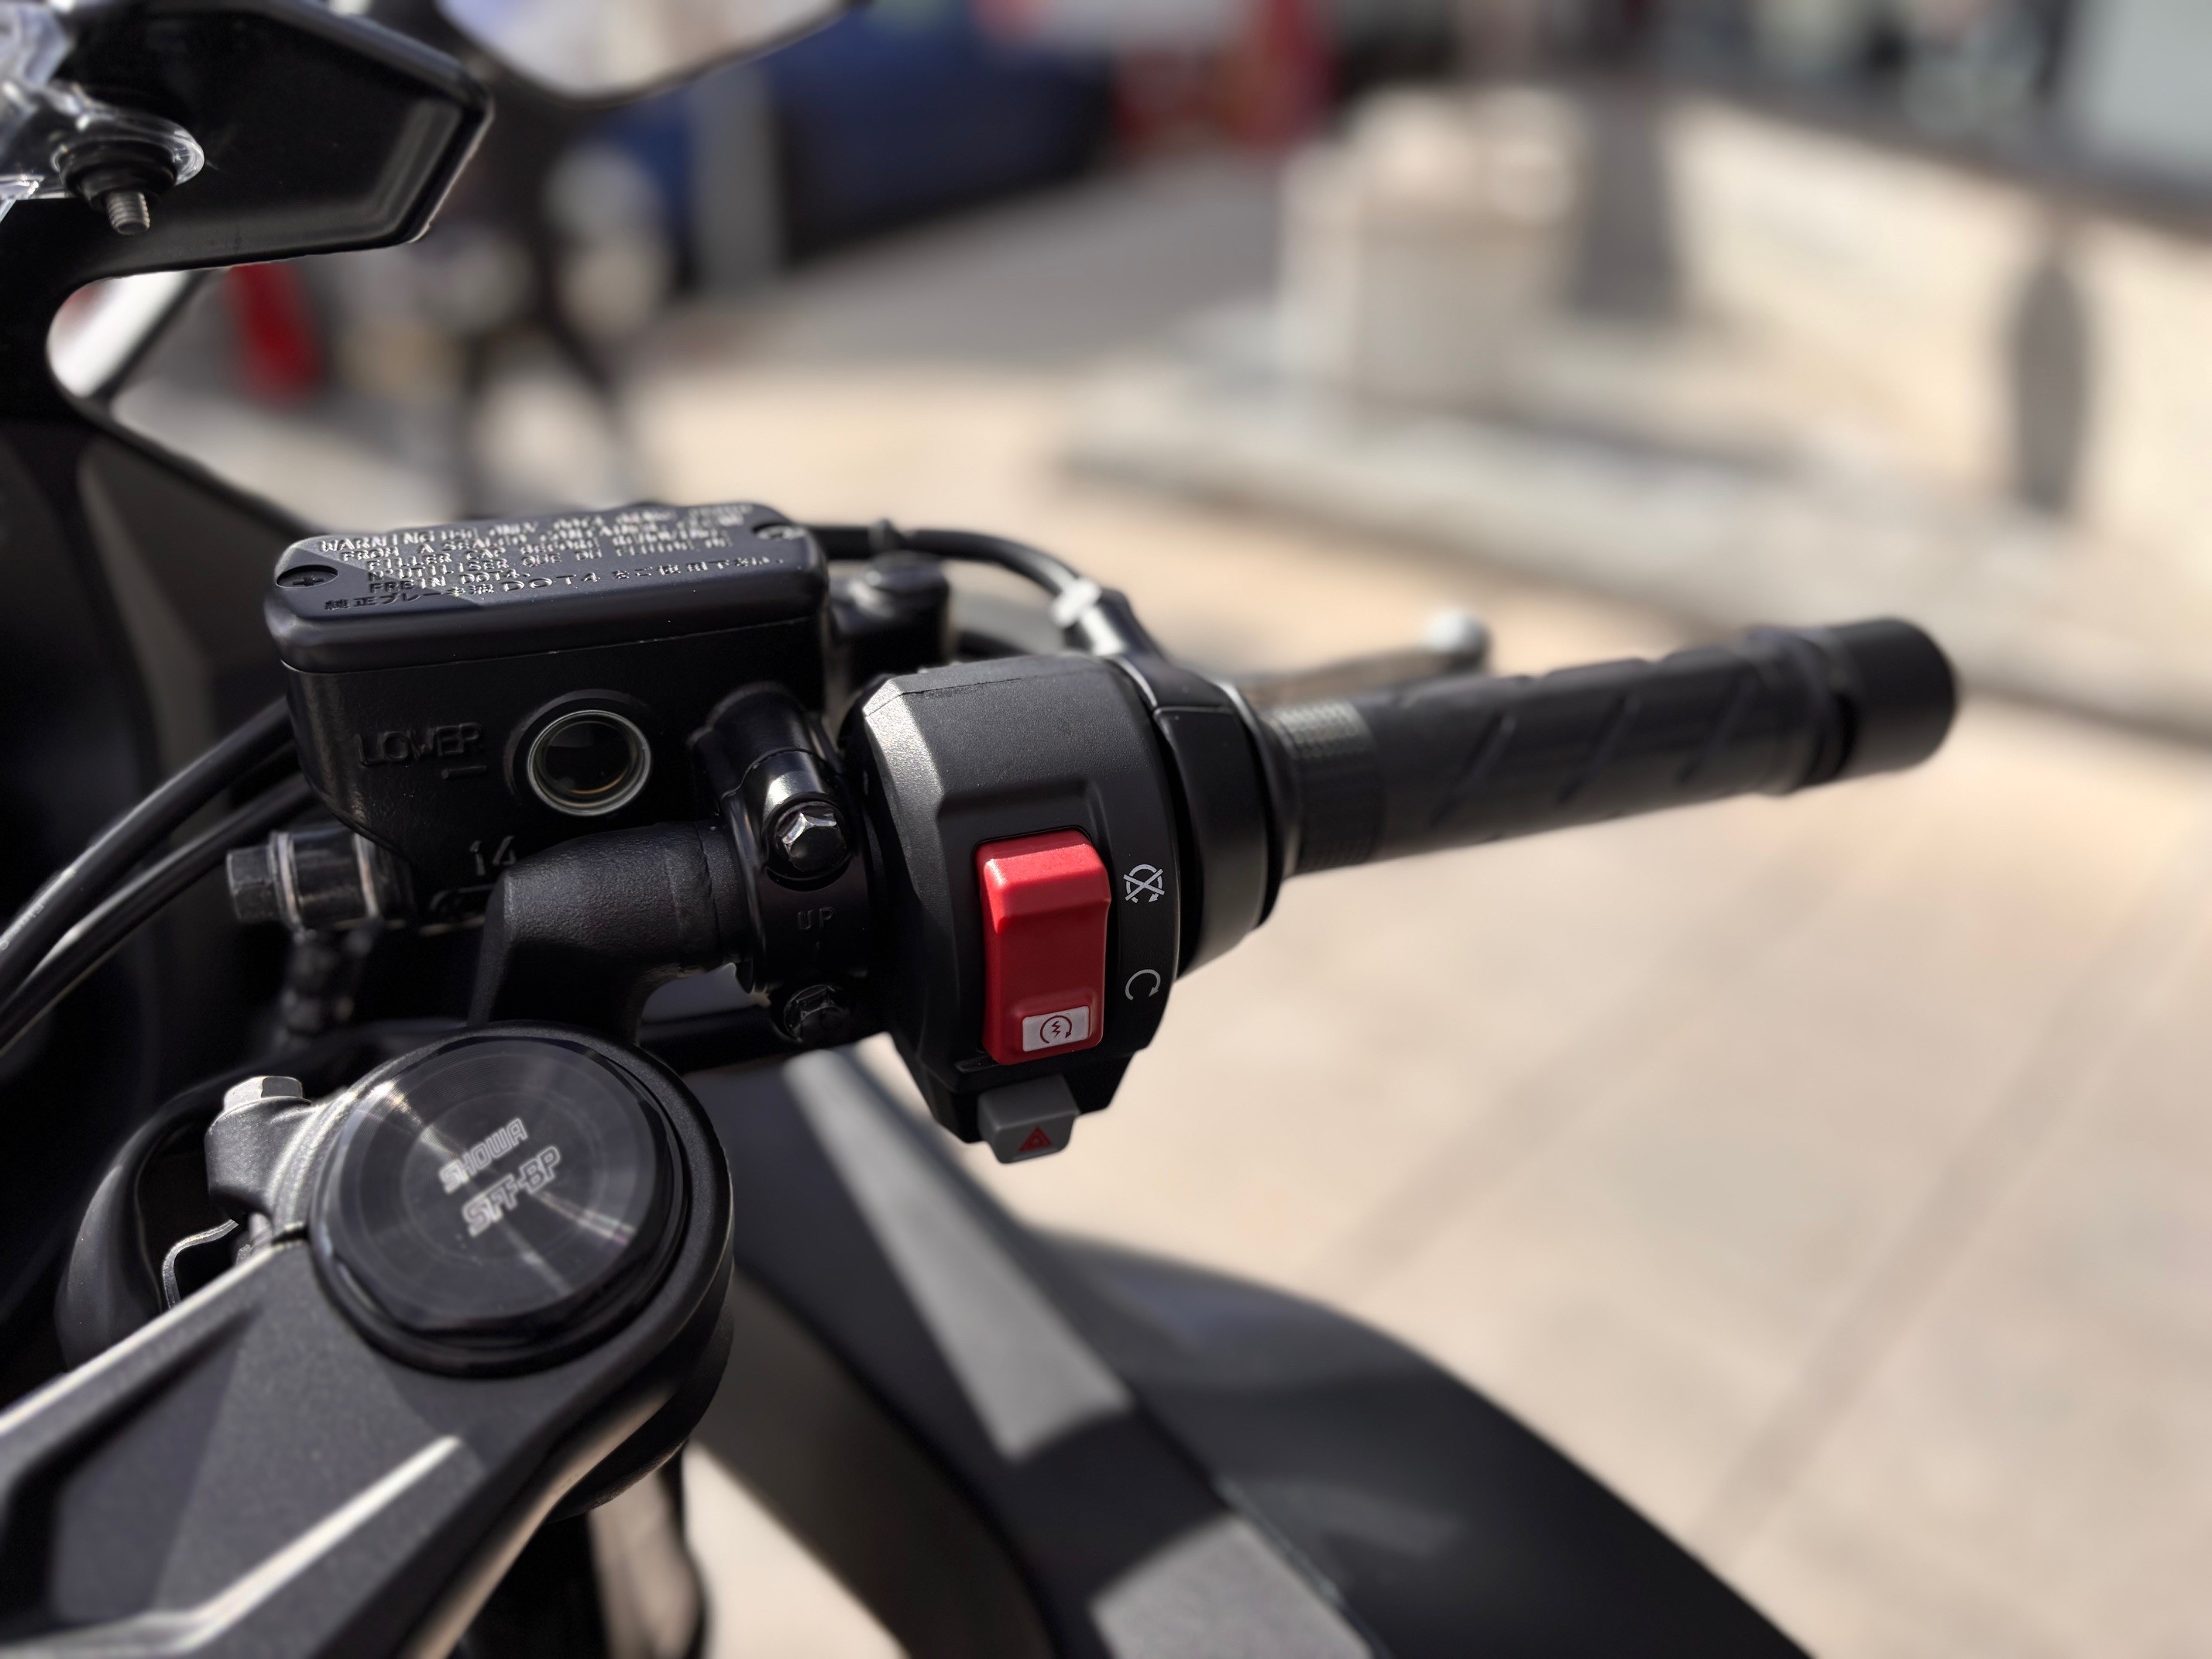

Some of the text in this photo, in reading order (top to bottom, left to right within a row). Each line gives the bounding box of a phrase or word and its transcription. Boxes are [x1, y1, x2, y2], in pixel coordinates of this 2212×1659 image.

[318, 527, 436, 552] WARNING
[338, 545, 400, 563] FROM
[418, 543, 435, 555] A
[366, 552, 452, 571] FILLER
[464, 546, 507, 562] CAP
[520, 551, 562, 568] QUE
[369, 575, 446, 594] FREIN
[354, 722, 483, 768] LOWER
[797, 906, 836, 930] UP
[438, 1117, 528, 1194] SHOWA
[462, 1146, 561, 1238] SFF-BP
